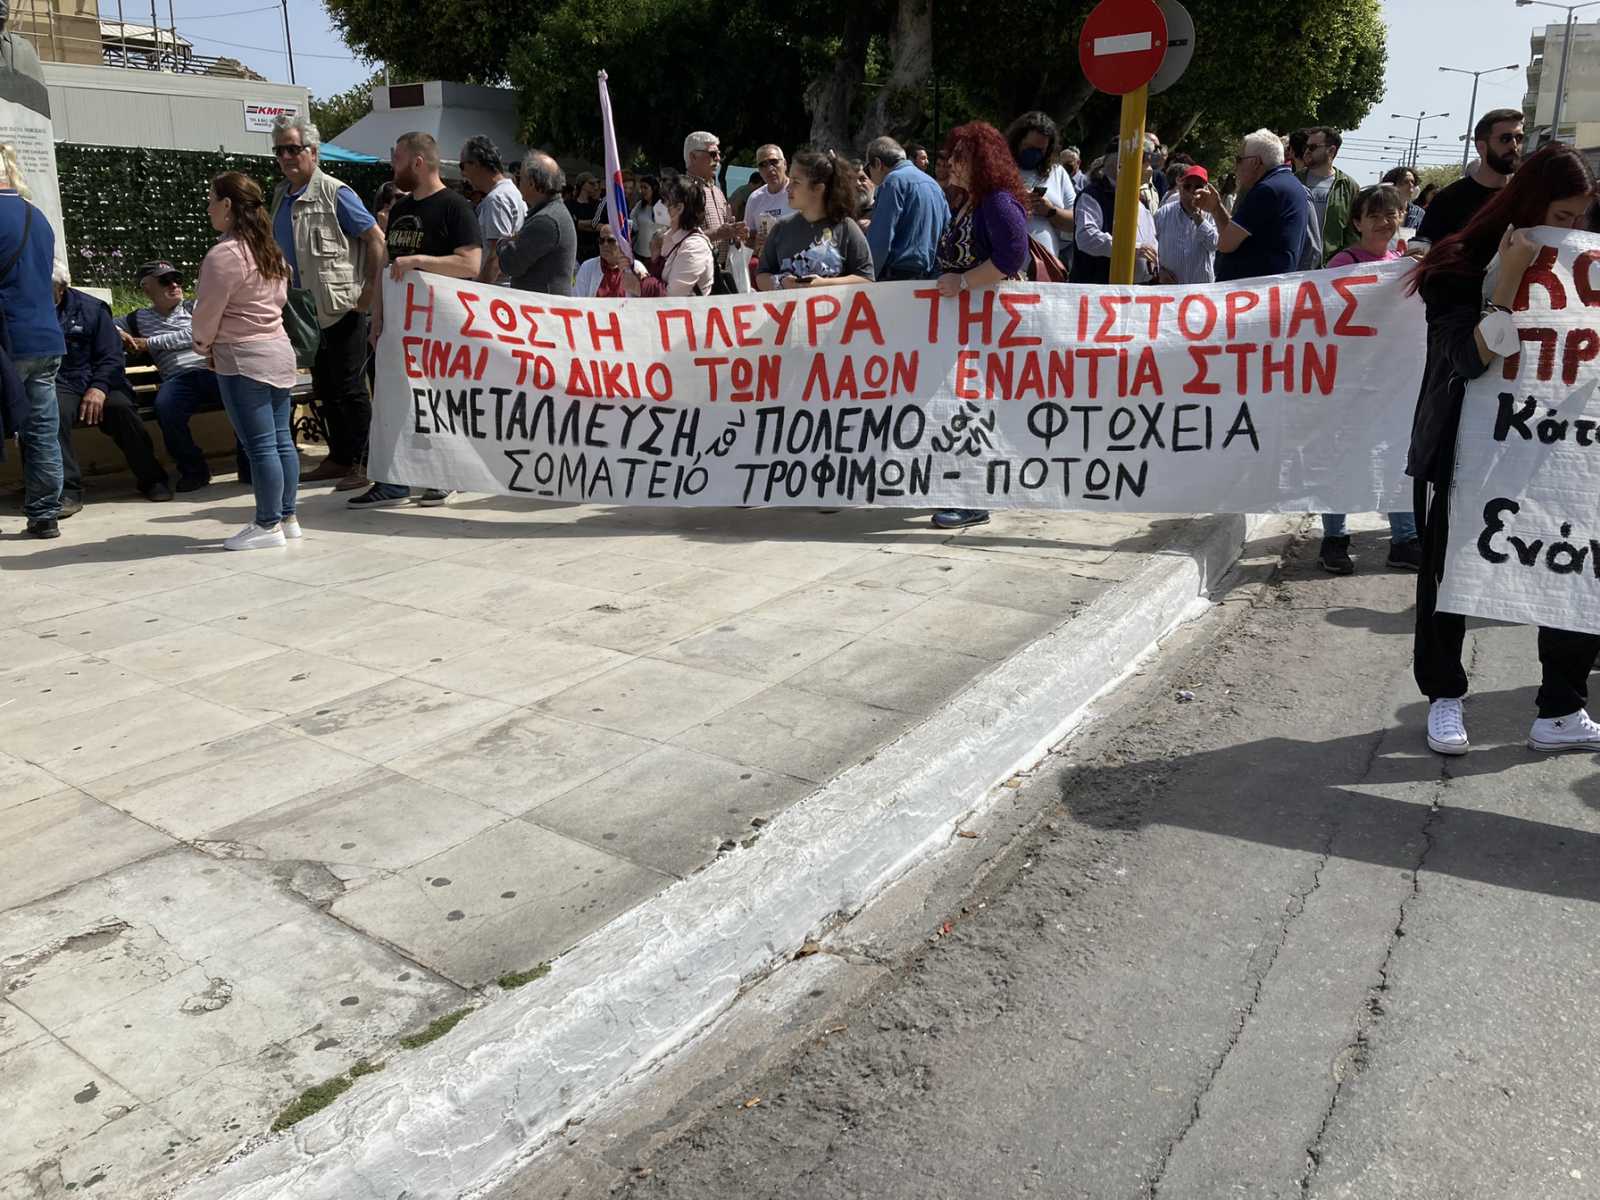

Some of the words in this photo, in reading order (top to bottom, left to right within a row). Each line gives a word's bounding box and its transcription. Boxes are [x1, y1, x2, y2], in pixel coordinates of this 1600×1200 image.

[405, 282, 434, 332] Η
[457, 291, 624, 351] ΣΩΣΤΗ
[657, 291, 885, 352] ΠΛΕΥΡΑ
[914, 290, 1041, 346] ΤΗΣ
[1077, 275, 1379, 342] ΙΣΤΟΡΙΑΣ
[403, 336, 488, 380] ΕΙΝΑΙ
[511, 350, 556, 390] ΤΟ
[566, 358, 672, 401] ΔΙΚΙΟ
[694, 356, 782, 402] ΤΩΝ
[802, 352, 919, 401] ΛΑΩΝ
[955, 346, 1162, 400] ΕΝΑΝΤΙΑ
[1183, 342, 1338, 395] ΣΤΗΝ
[756, 404, 926, 455] ΠΟΛΕΜΟ
[1027, 402, 1260, 453] ΦΤΩΧΕΙΑ
[1493, 392, 1600, 447] Κάτ
[504, 449, 708, 500] ΣΩΜΑΤΕΙΟ
[735, 452, 931, 504] ΤΡΟΦΙΜΩΝ
[986, 456, 1149, 500] ΠΟΤΩΝ
